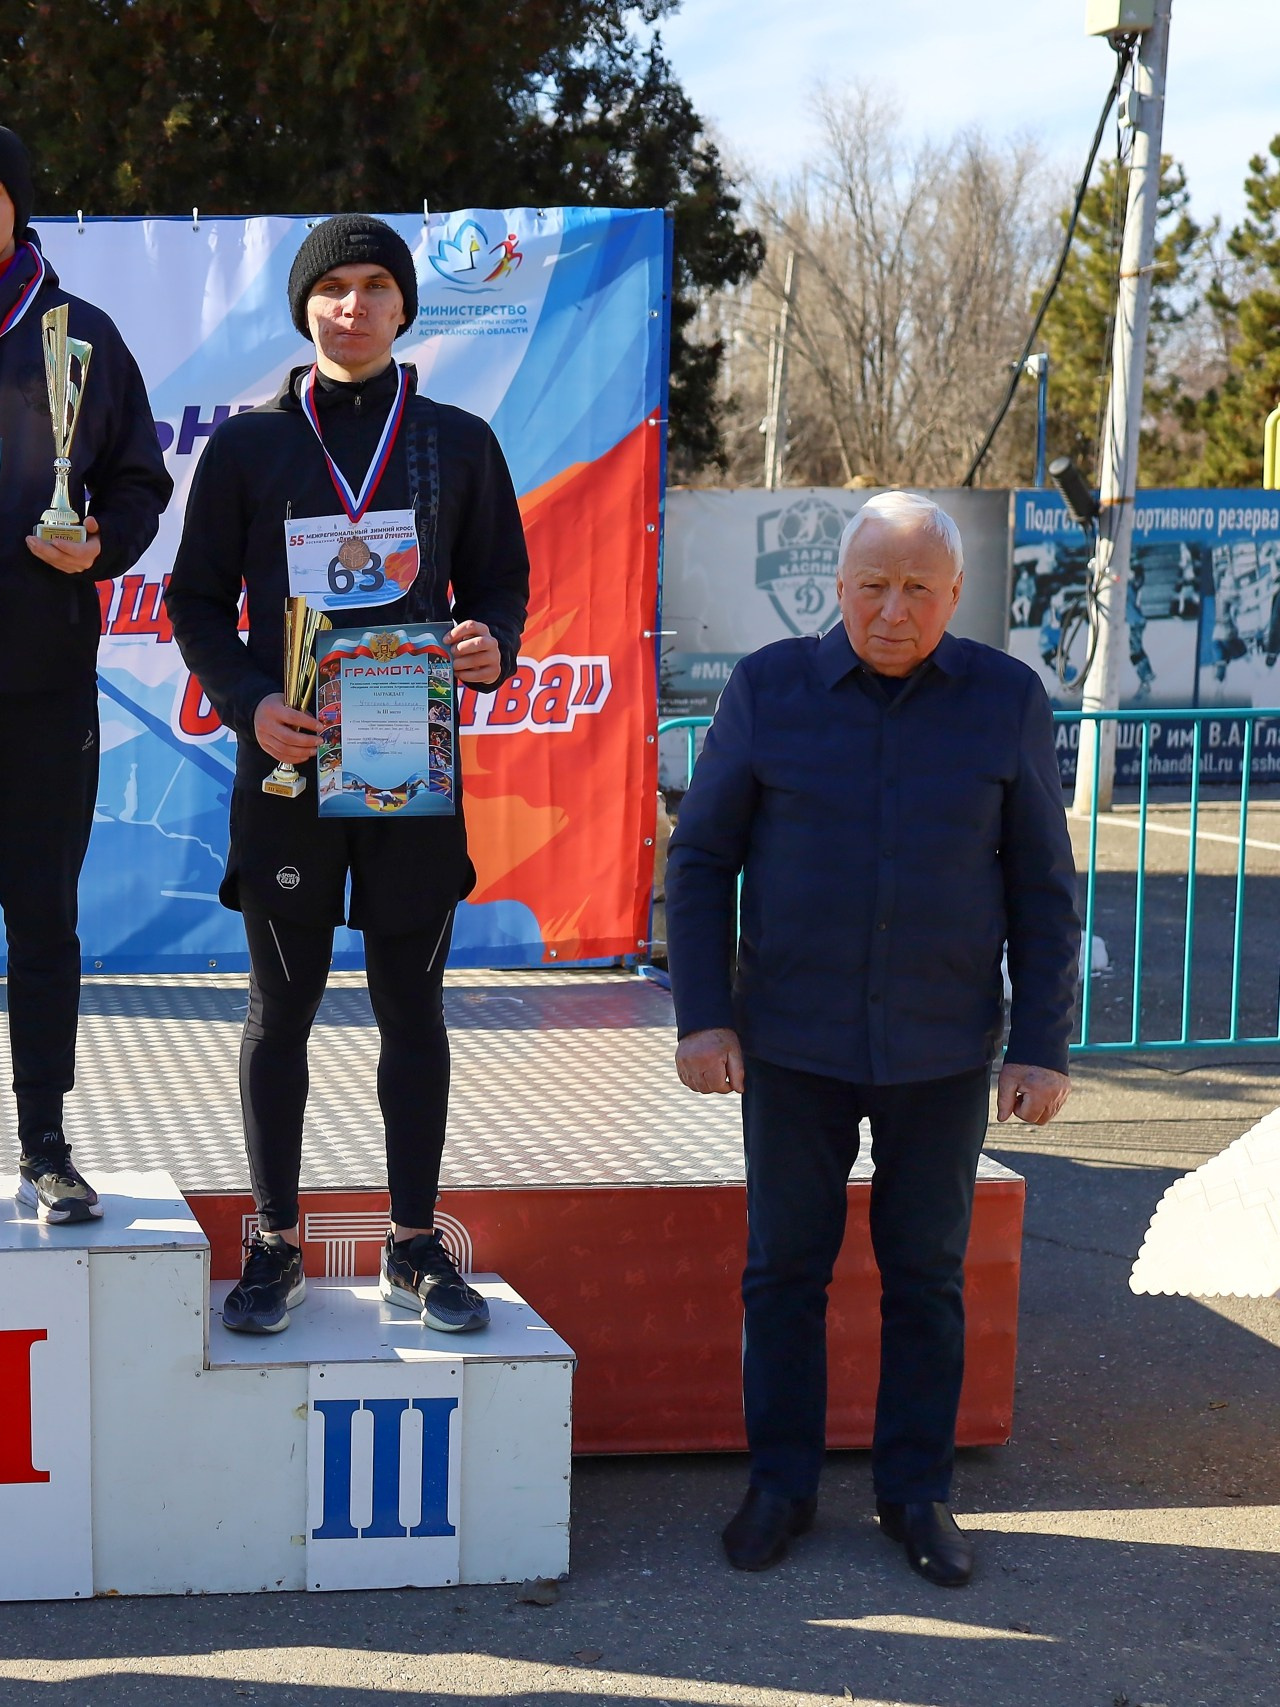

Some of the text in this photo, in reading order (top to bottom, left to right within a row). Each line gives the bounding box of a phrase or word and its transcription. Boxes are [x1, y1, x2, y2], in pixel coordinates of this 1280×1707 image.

[420, 305, 527, 316] МИНИСТЕРСТВО
[419, 327, 528, 337] АСТРАХАНСКОЙ ОБЛАСТИ
[1218, 506, 1279, 537] резерва
[289, 535, 305, 547] 55
[306, 529, 368, 539] МЕЖРЕГИОНАЛЬНЫЙ
[370, 525, 395, 534] ЗИМНИЙ
[789, 549, 833, 561] ЗАРЯ
[327, 552, 385, 594] 63
[779, 562, 837, 577] КАСПИ
[344, 665, 425, 678] ГРАМОТА
[312, 1397, 459, 1540] III
